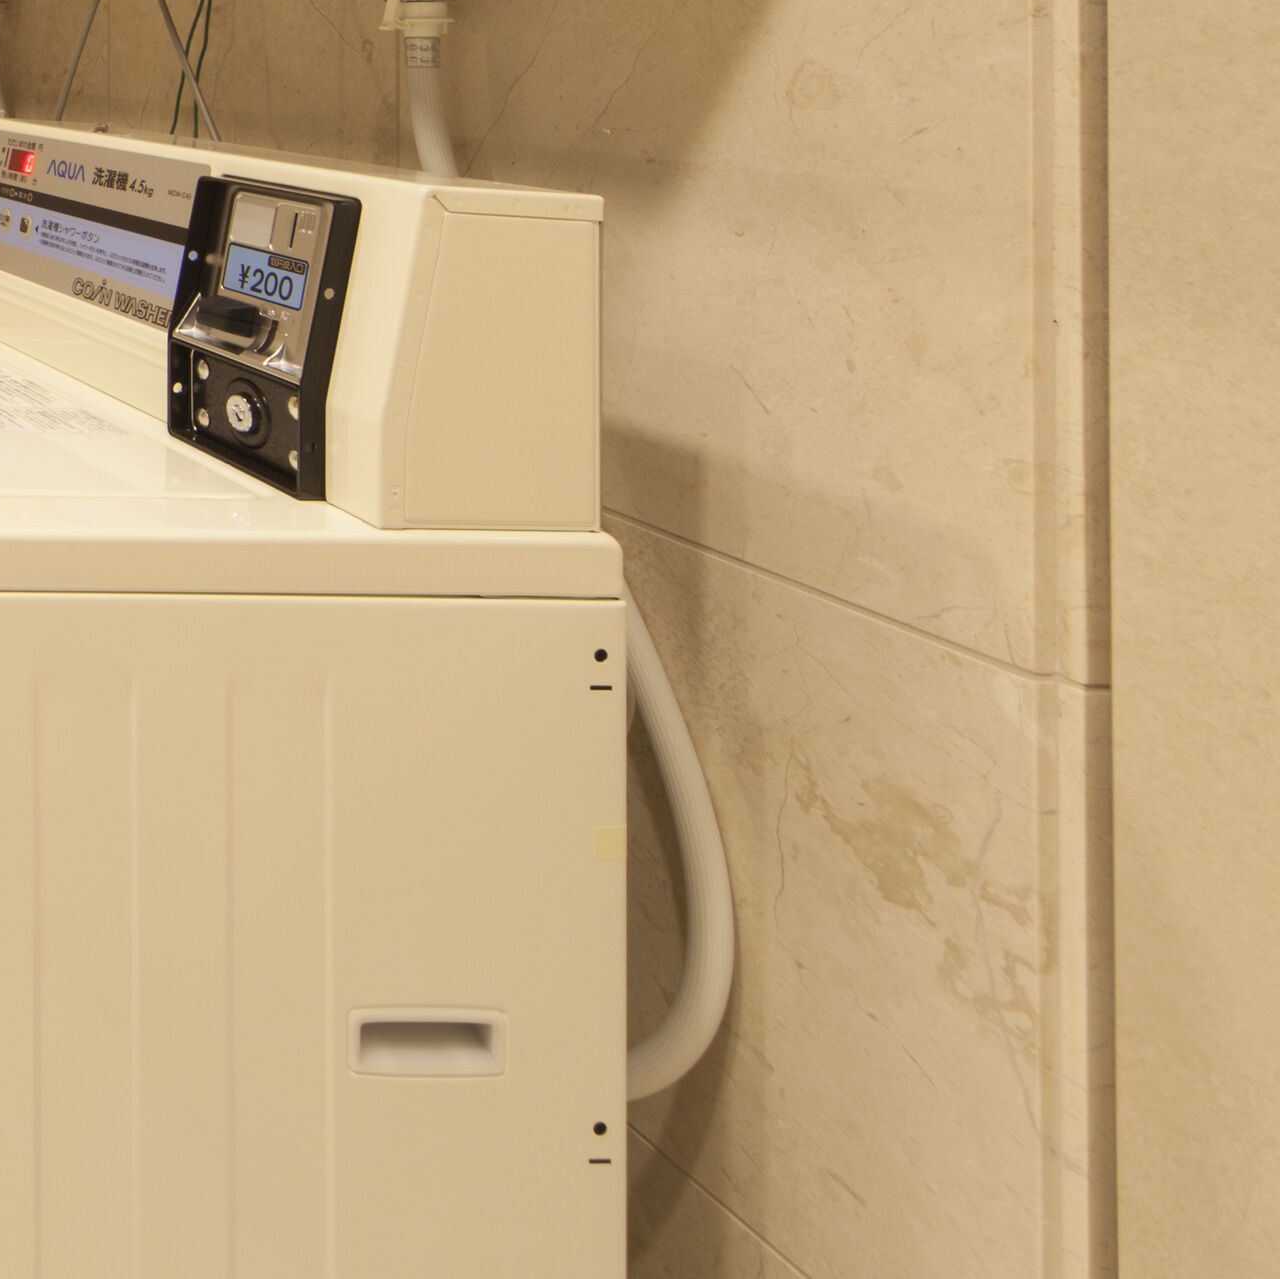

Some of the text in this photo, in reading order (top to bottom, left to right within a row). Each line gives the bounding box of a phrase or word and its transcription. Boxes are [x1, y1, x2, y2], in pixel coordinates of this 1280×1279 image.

[46, 159, 154, 198] AQUA 洗濯機 4.5kg
[72, 277, 113, 307] COIN
[238, 263, 294, 301] ¥200
